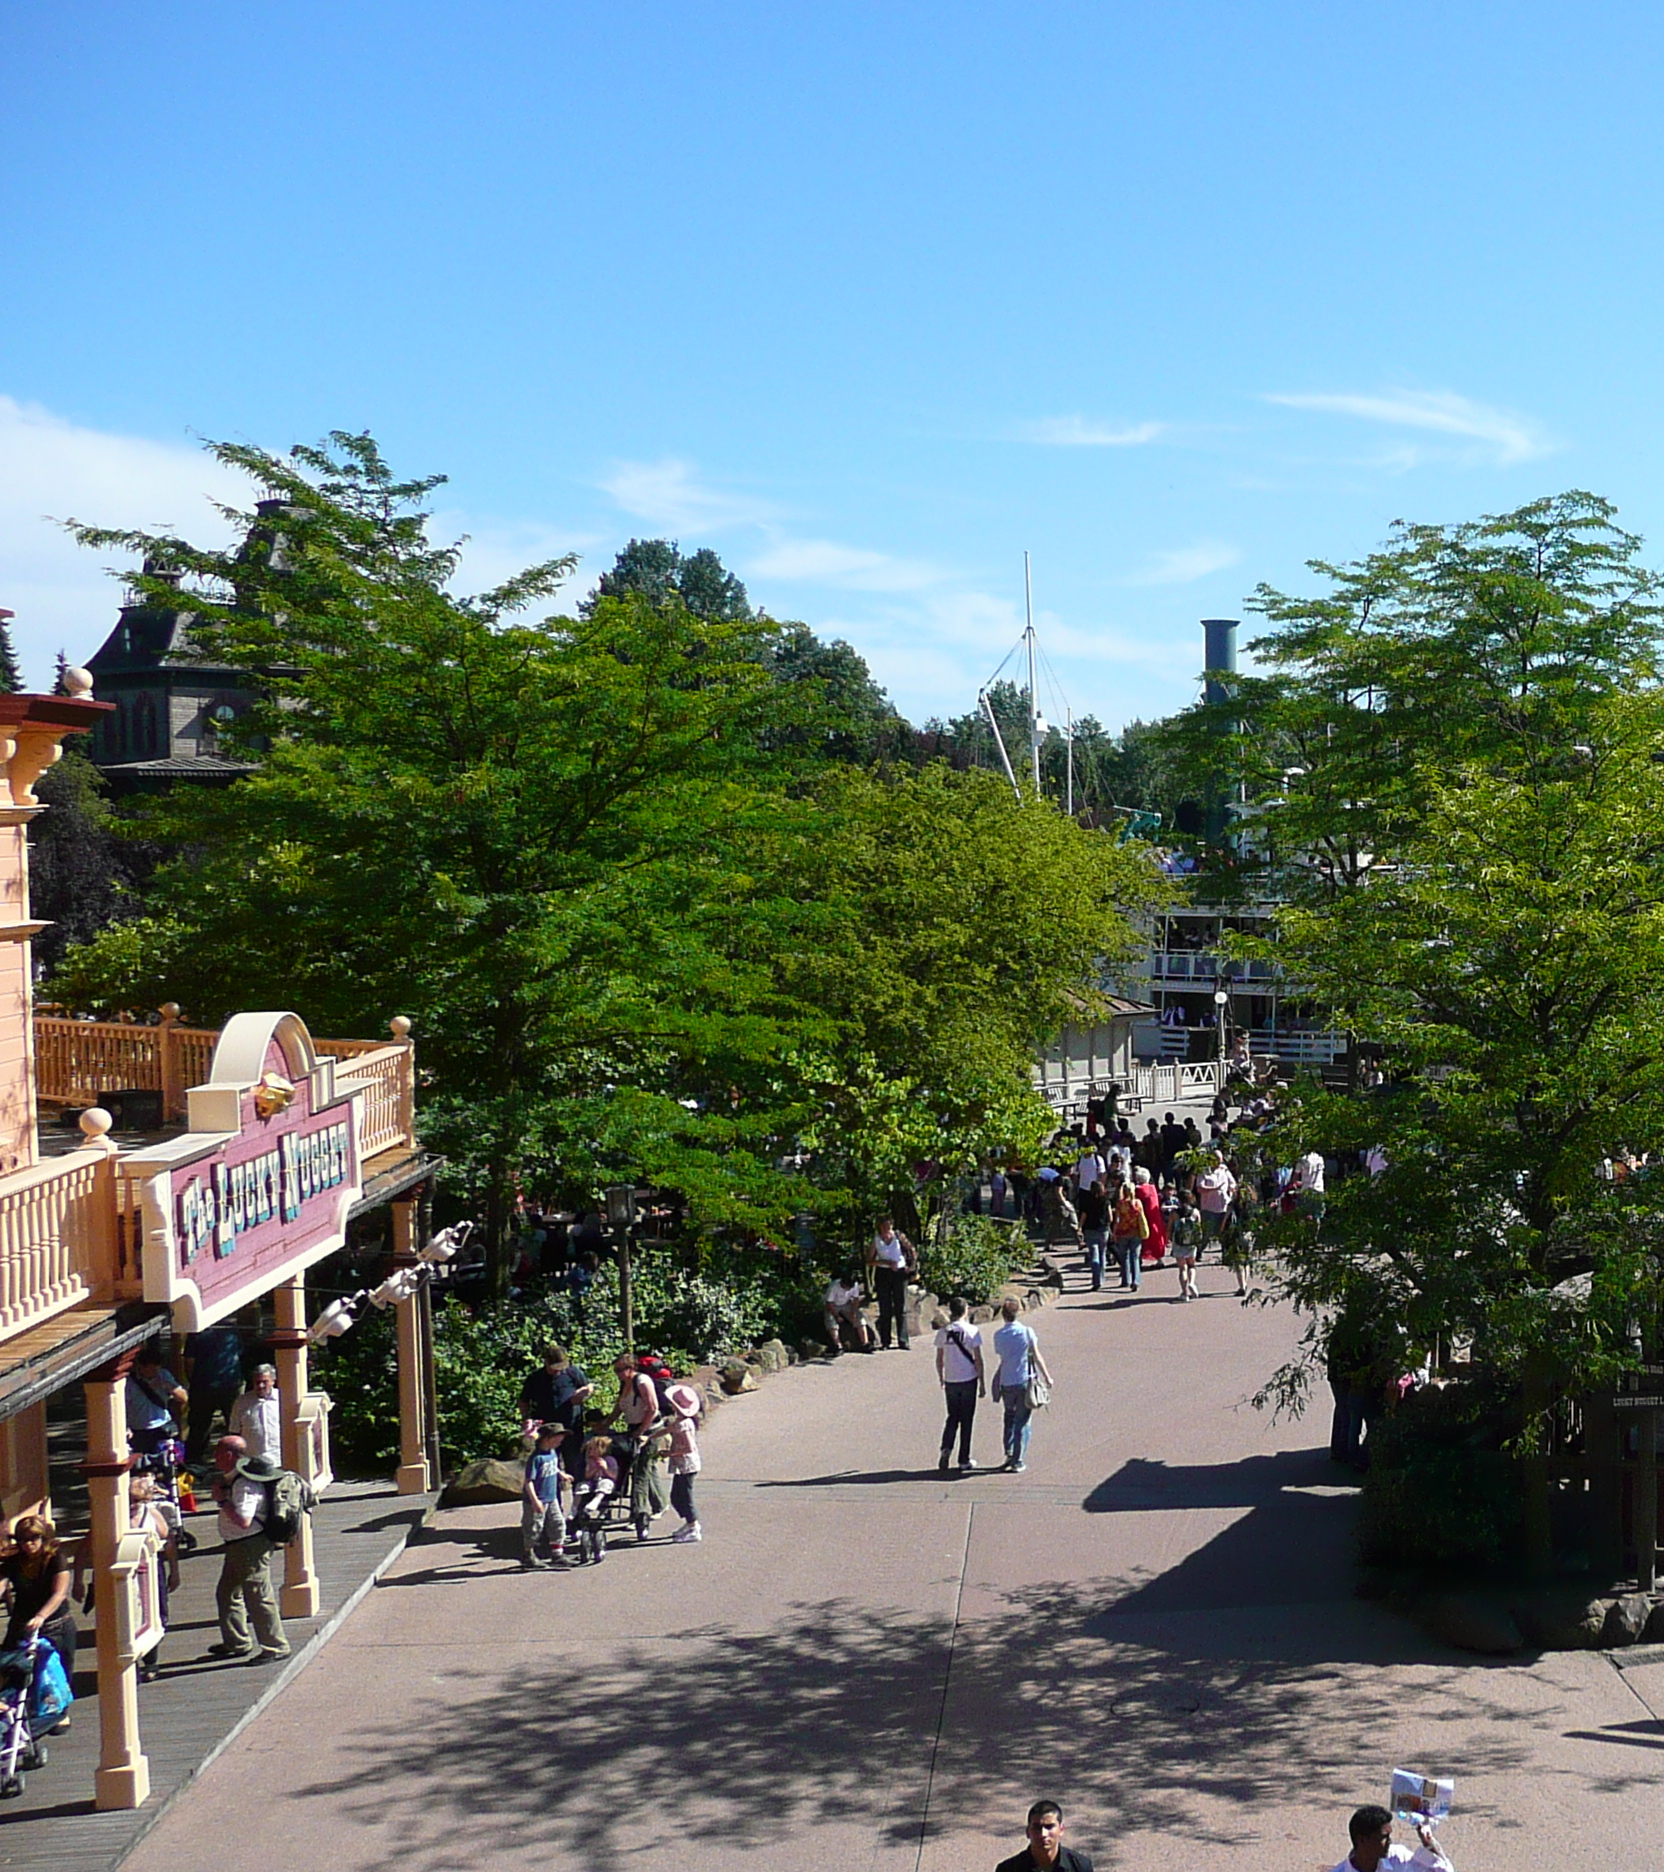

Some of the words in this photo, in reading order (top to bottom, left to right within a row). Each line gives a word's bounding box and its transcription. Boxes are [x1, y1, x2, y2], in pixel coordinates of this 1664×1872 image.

[180, 1175, 215, 1266] The
[213, 1150, 281, 1259] LUCKY
[281, 1121, 348, 1223] NUGGET
[1613, 1397, 1634, 1407] LUCKY
[1634, 1396, 1659, 1406] NUGGET
